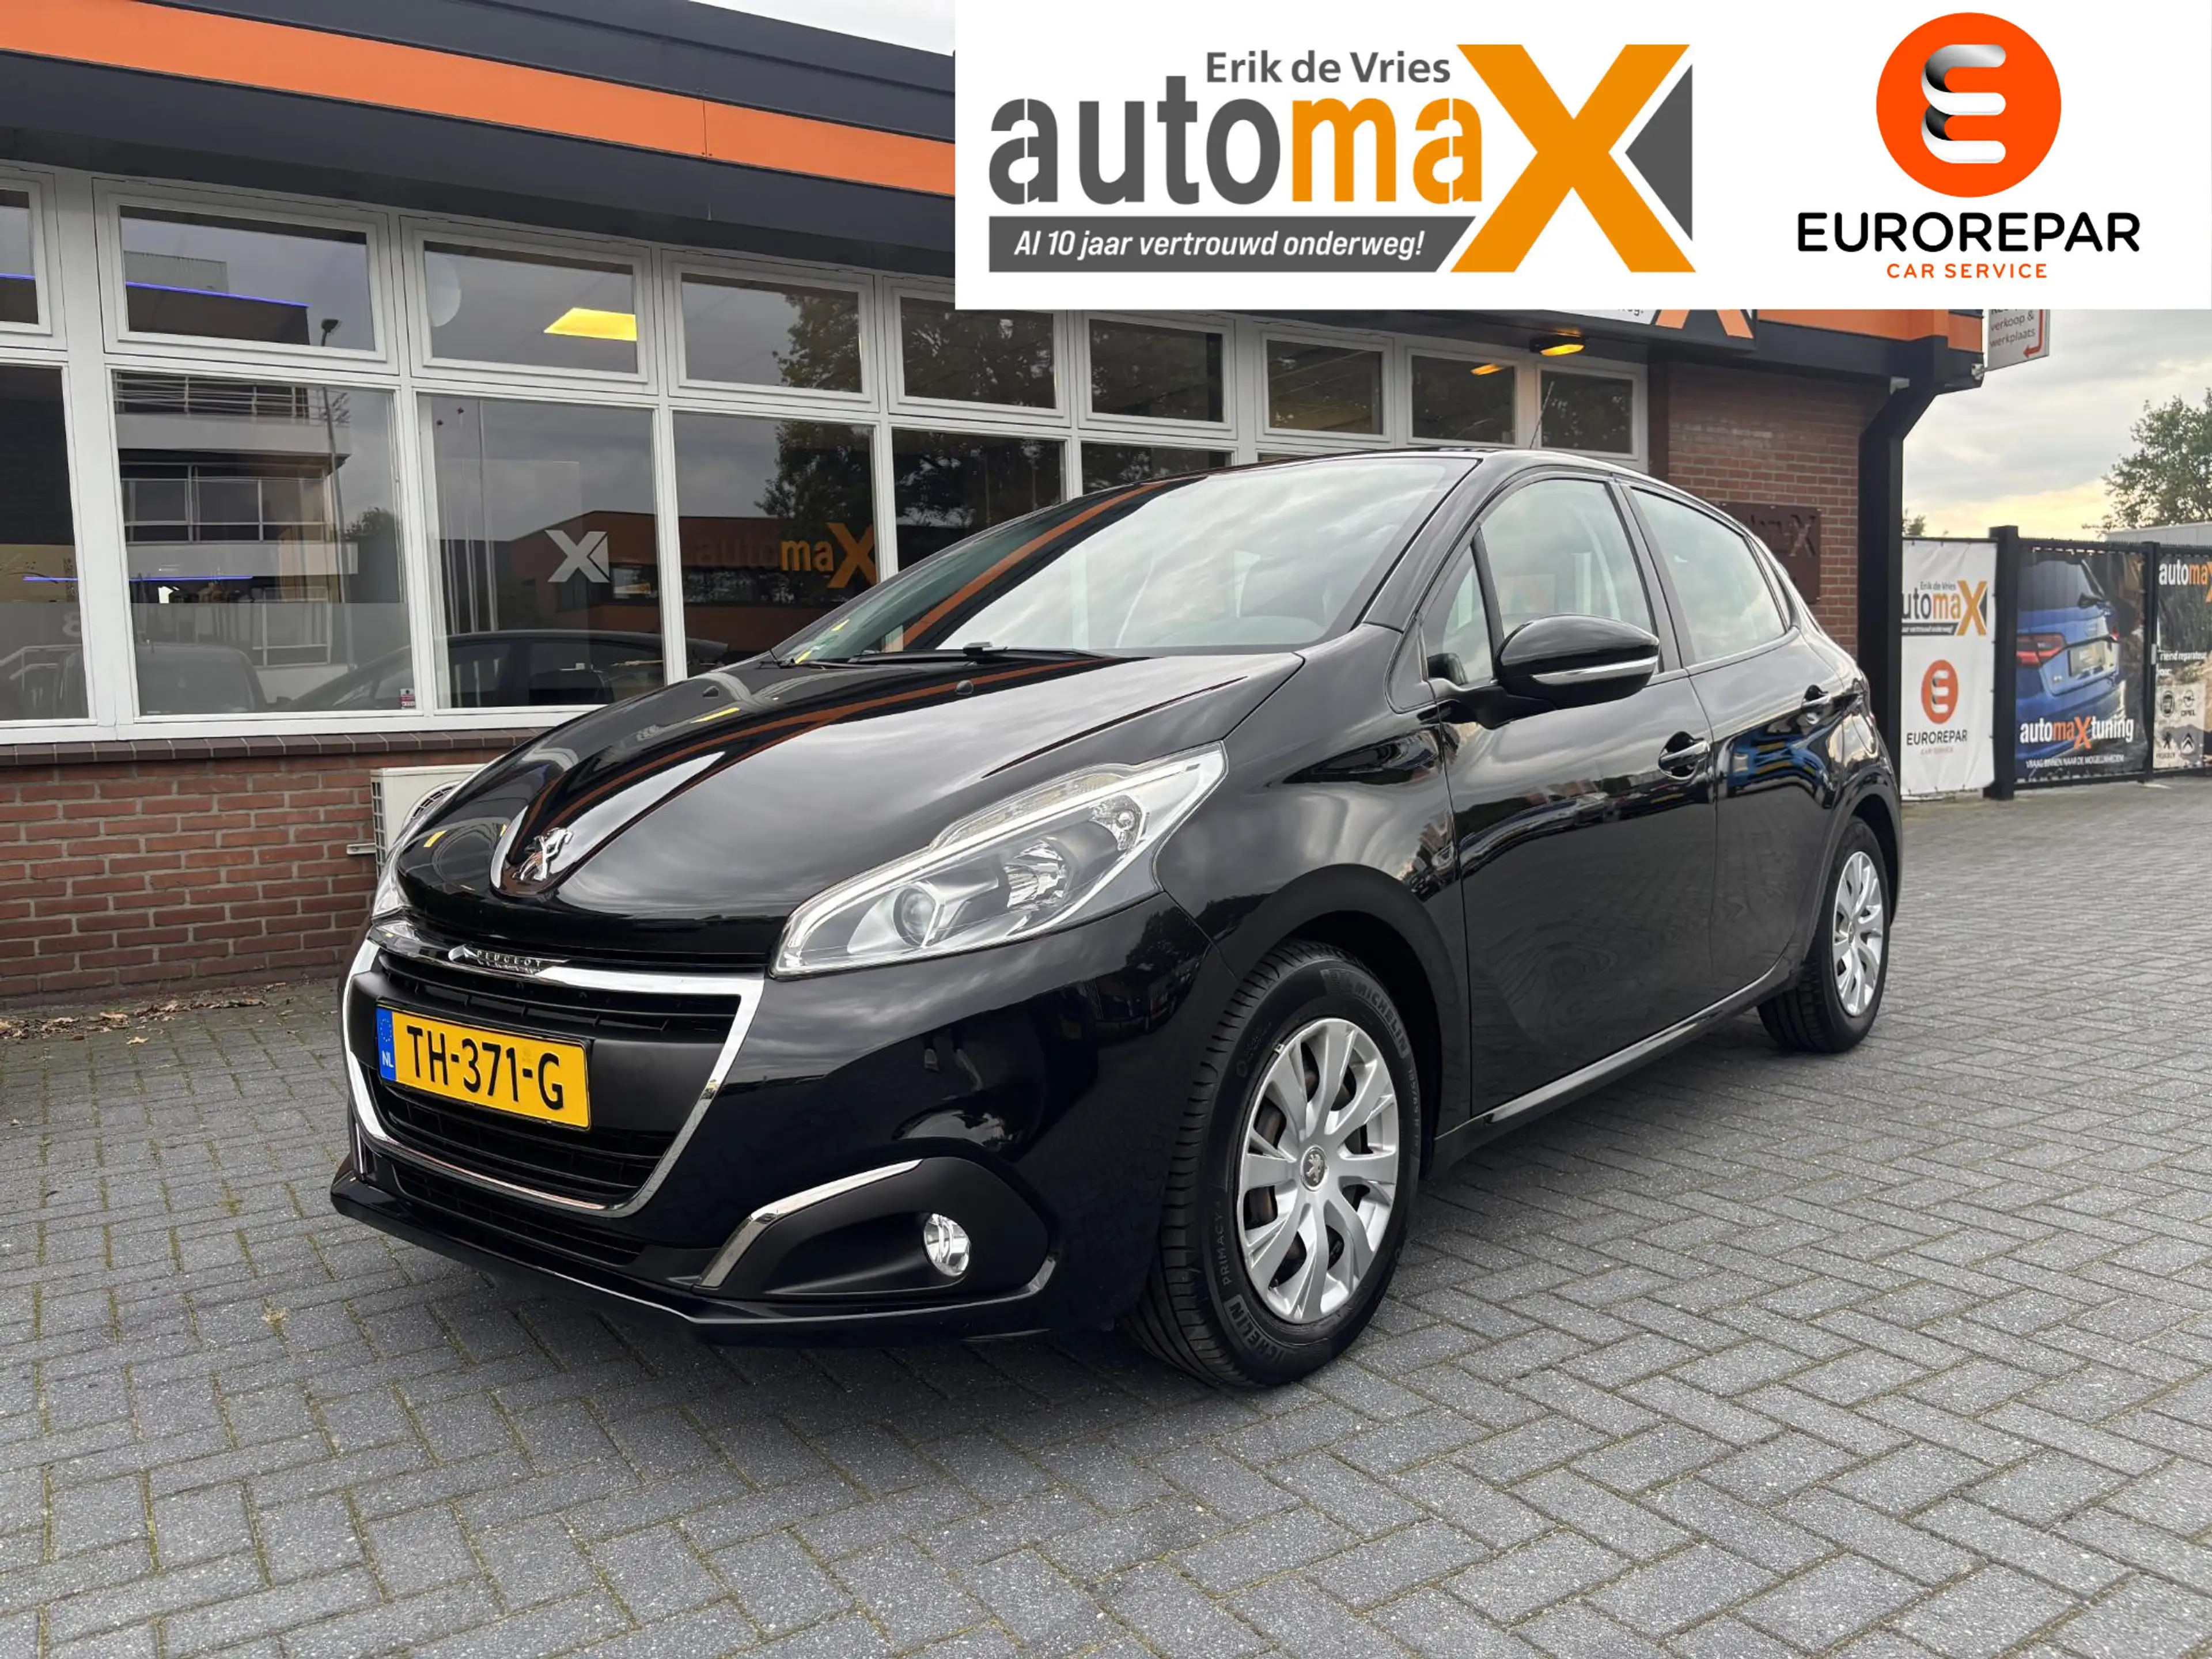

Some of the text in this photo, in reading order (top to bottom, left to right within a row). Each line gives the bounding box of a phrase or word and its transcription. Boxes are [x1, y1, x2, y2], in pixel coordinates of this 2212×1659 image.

[1990, 315, 2025, 331] verkoop
[1989, 328, 2036, 348] werkplaats
[1906, 729, 1968, 745] EUROREPAR
[478, 950, 542, 968] PEUGEOT
[1355, 981, 1410, 1054] MICHELIN
[382, 1050, 394, 1068] NL
[407, 1025, 565, 1111] TH-371-G
[1214, 1210, 1233, 1286] PRIMACY
